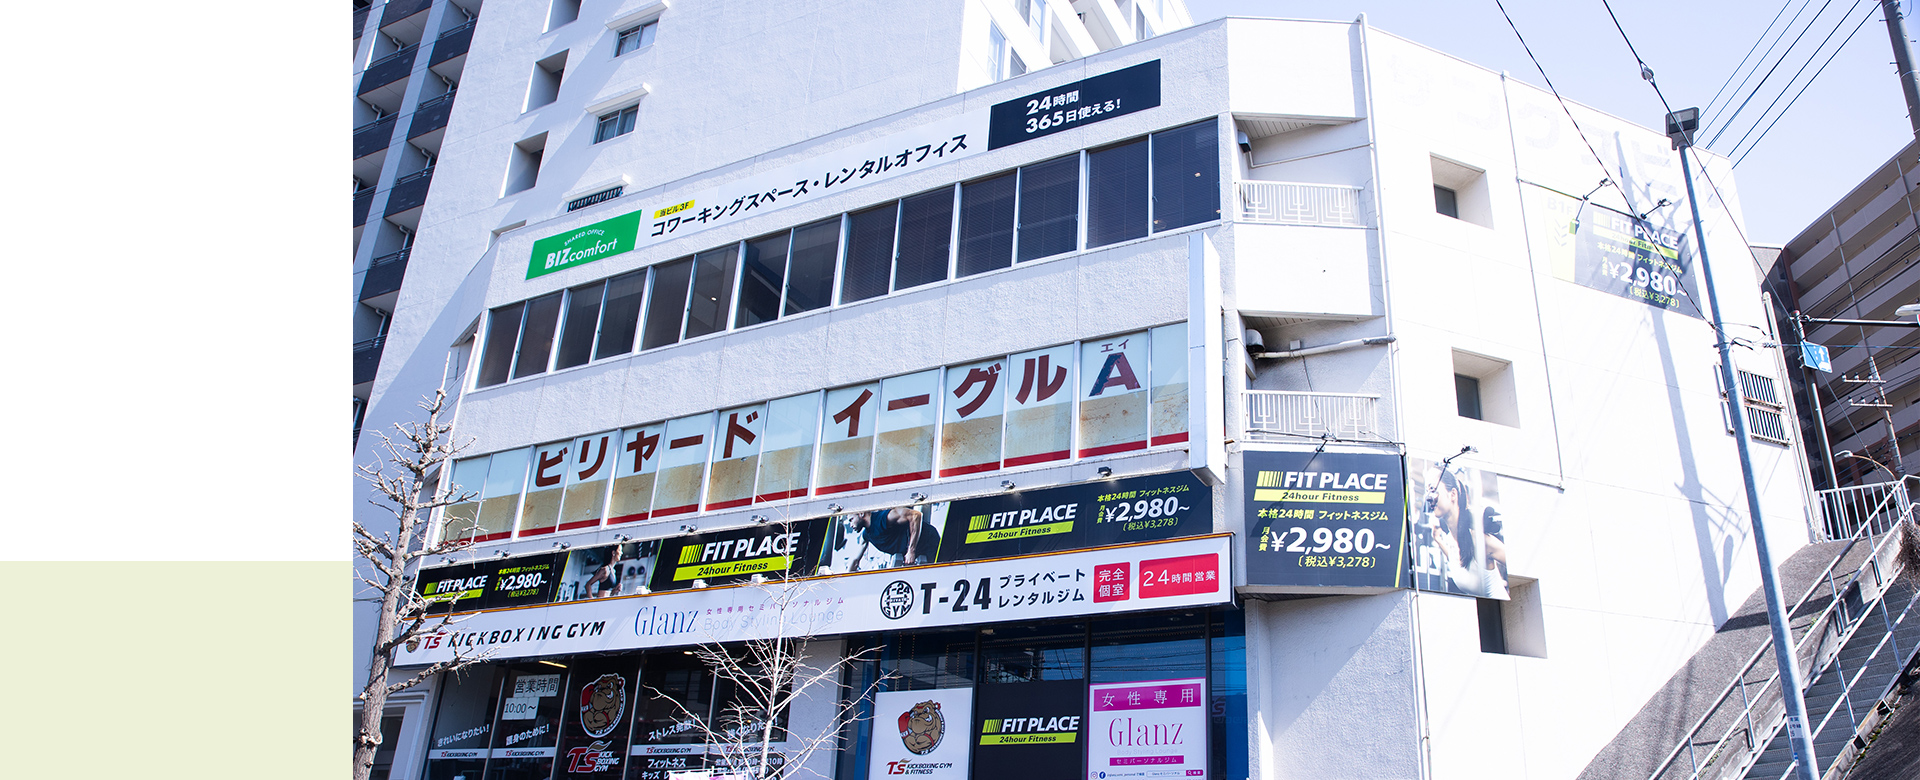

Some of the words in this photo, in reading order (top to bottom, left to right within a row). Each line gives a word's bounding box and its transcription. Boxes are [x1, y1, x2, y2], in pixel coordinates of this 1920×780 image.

[1026, 90, 1079, 115] 24時間
[1025, 98, 1121, 133] 365日使える!
[1611, 217, 1632, 234] FIT
[564, 231, 586, 246] SHARED
[1101, 338, 1129, 353] エイ
[535, 410, 758, 487] ビリヤード
[833, 354, 1067, 437] イーグル
[1089, 351, 1141, 397] A
[1284, 471, 1317, 488] FIT
[1320, 472, 1388, 490] PLACE
[1282, 491, 1320, 501] 24hour
[1322, 492, 1359, 502] Fitness
[990, 510, 1020, 529] FIT
[1019, 503, 1078, 525] PLACE
[1257, 508, 1314, 519] 本格24時間
[1318, 510, 1388, 521] フィットネスジム
[987, 531, 1018, 541] 24hour
[1020, 525, 1051, 537] Fitness
[1258, 526, 1270, 551] 月会費
[701, 539, 735, 562] FIT
[733, 533, 801, 559] PLACE
[697, 566, 732, 577] 24hour
[733, 561, 768, 572] Fitness
[1098, 567, 1125, 582] 完全
[436, 580, 455, 593] FIT
[455, 575, 488, 592] PLACE
[999, 568, 1086, 589] プライベート
[1142, 570, 1216, 587] 24時間営業
[886, 582, 910, 595] T-24
[921, 577, 991, 615] T-24
[1098, 583, 1125, 598] 個室
[999, 589, 1085, 608] レンタルジム
[883, 605, 911, 617] GYM
[634, 605, 698, 636] Glanz
[704, 616, 734, 632] Body
[791, 609, 844, 625] Lounge
[447, 625, 563, 647] KICKBOXING
[567, 621, 606, 637] GYM
[515, 677, 559, 695] 営業時間
[1102, 688, 1194, 707] 女性専用
[1001, 718, 1027, 733] FIT
[1027, 716, 1080, 732] PLACE
[1109, 717, 1184, 747] Glanz
[999, 735, 1027, 743] 24hour
[1028, 734, 1056, 743] Fitness
[647, 757, 686, 769] フィットネス
